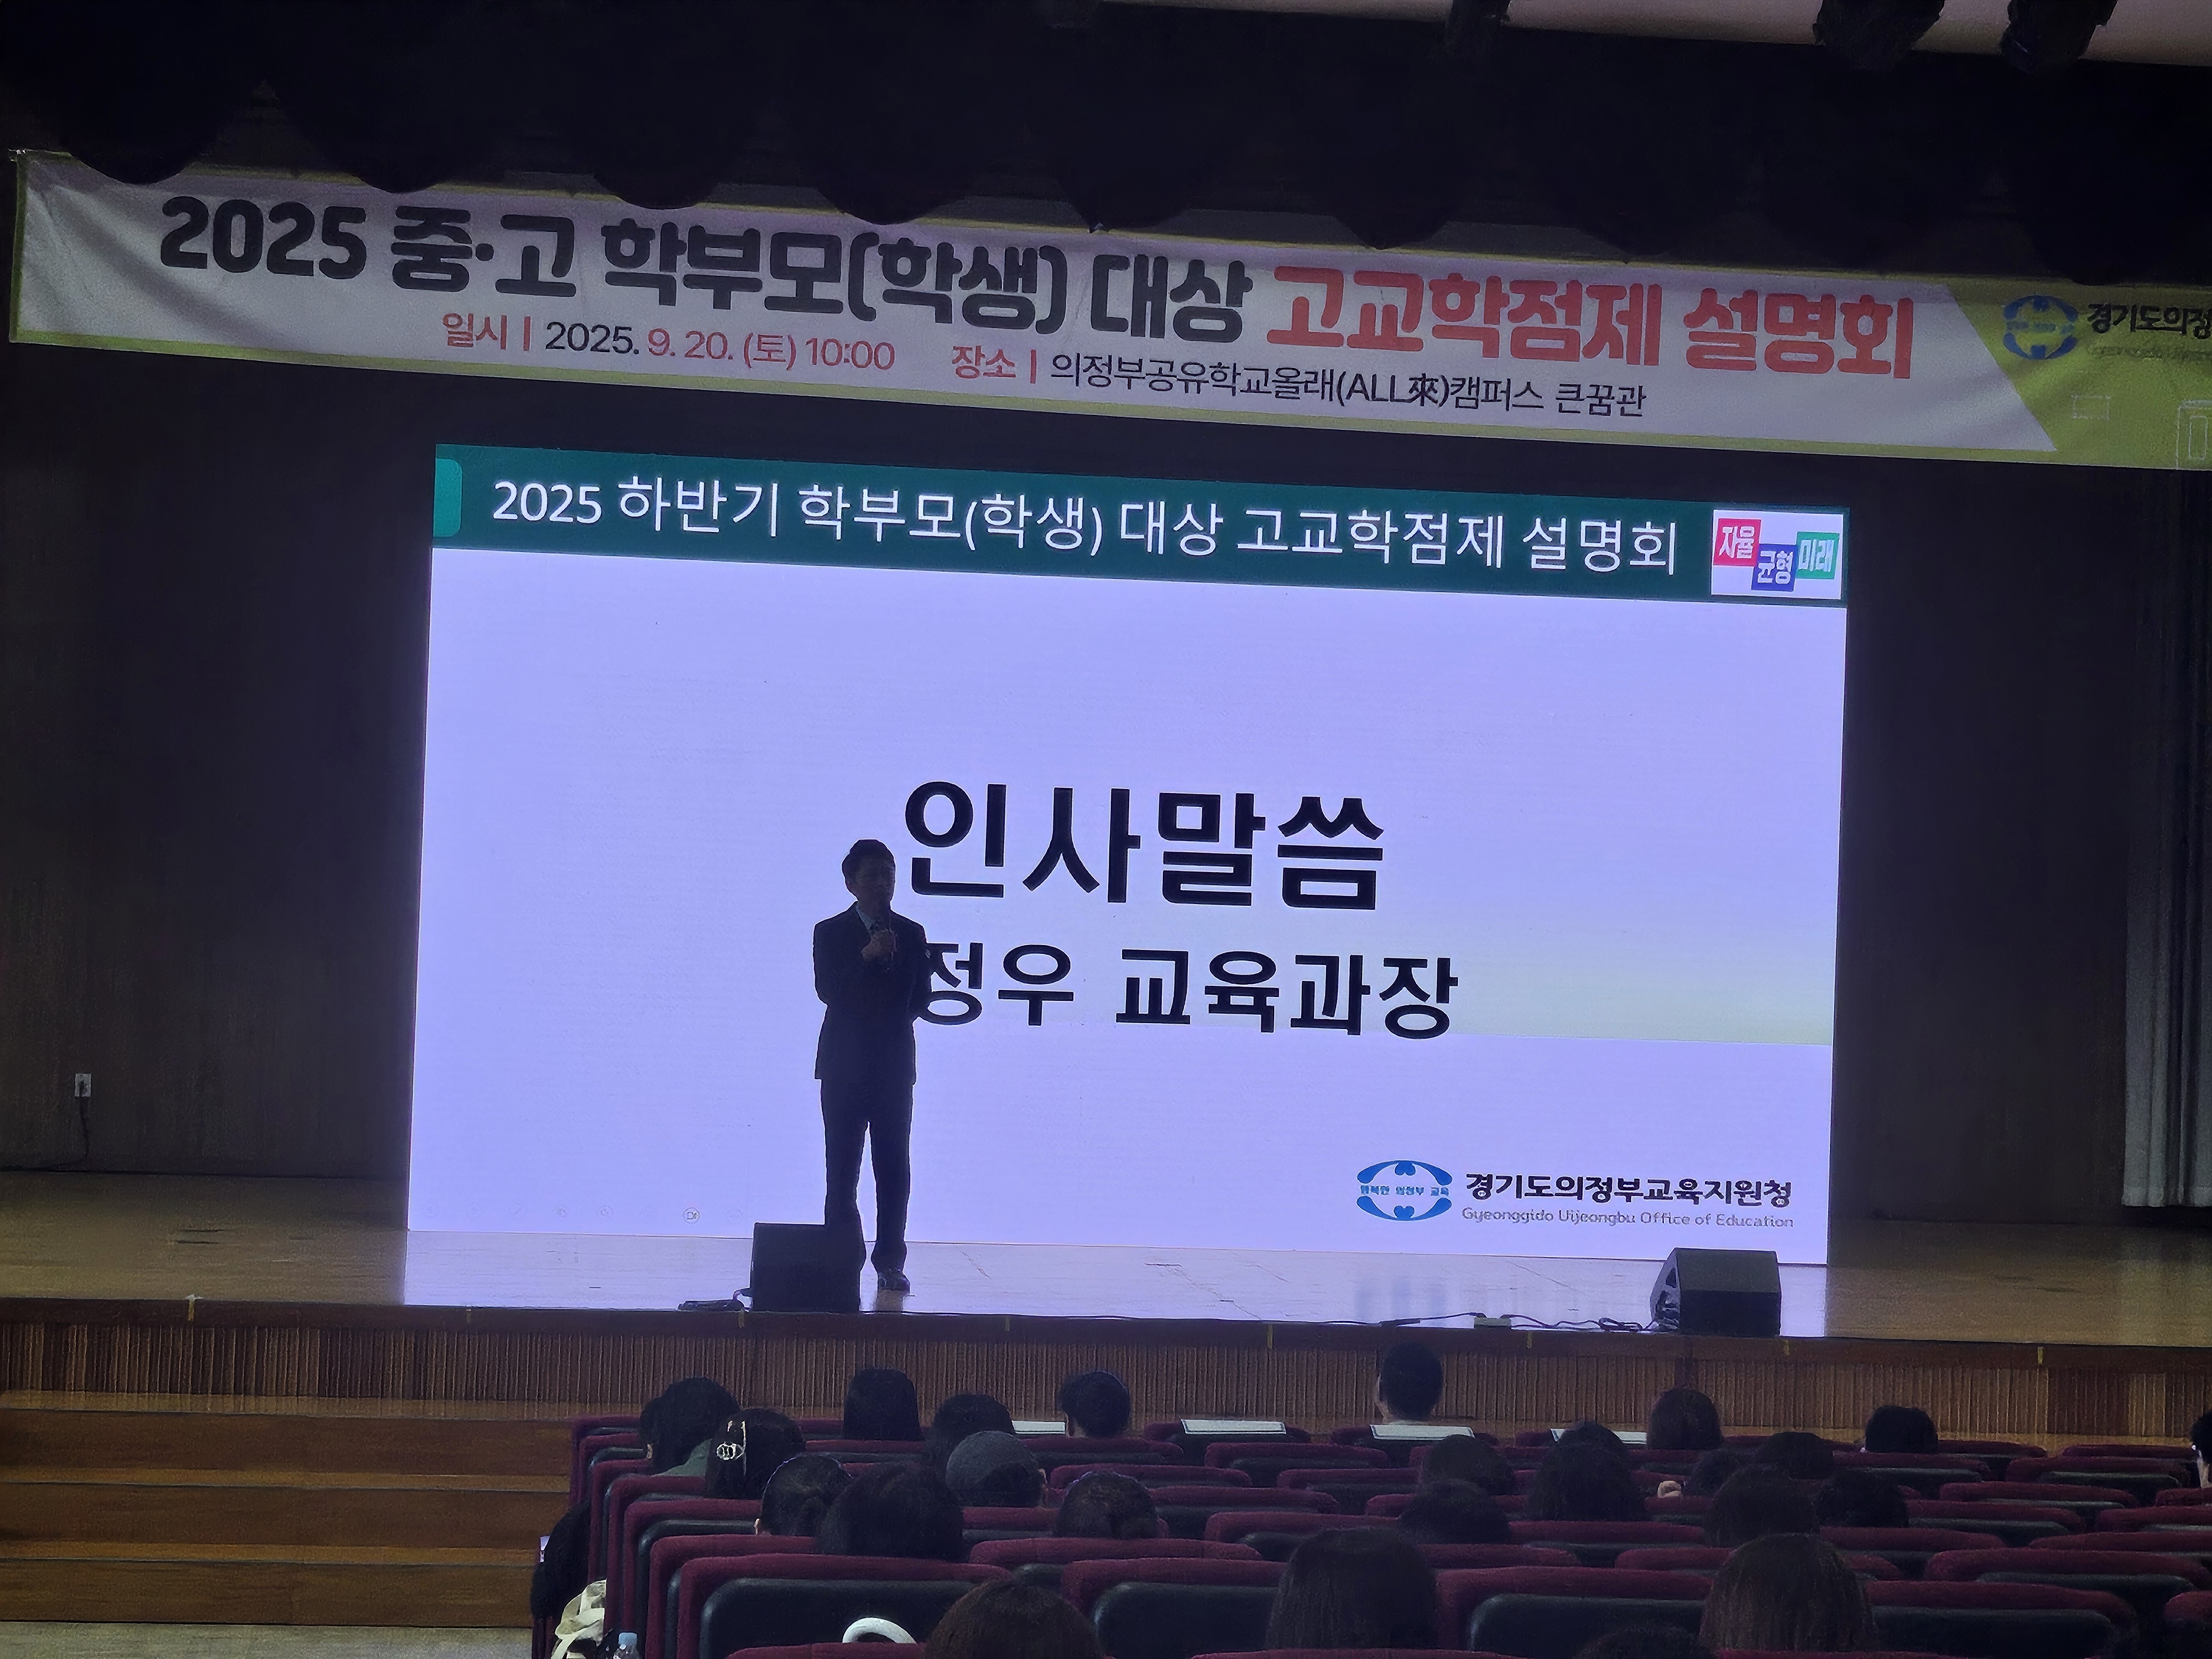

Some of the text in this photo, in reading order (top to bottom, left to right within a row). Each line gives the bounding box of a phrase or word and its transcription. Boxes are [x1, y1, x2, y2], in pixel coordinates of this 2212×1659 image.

[161, 196, 366, 279] 2025
[601, 218, 1068, 334] 학부모(학생)
[1091, 254, 1253, 343] 대상
[1266, 265, 1662, 366] 고교학점제
[1683, 288, 1914, 379] 설명회
[443, 313, 507, 349] 일시
[806, 338, 895, 370] 10:00
[952, 346, 1016, 379] 장소
[1556, 384, 1646, 416] 큰꿈관
[493, 476, 1675, 575] 2025 하반기 학부모(학생) 대상 고교학점제 설명회
[1798, 539, 1834, 572] 미래
[1757, 550, 1793, 584] 균형
[905, 781, 1384, 910] 인사말씀
[1116, 950, 1458, 1039] 교육과장
[1462, 1207, 1793, 1227] Gyeonggido Uijeongbu Office of Education
[1466, 1173, 1792, 1208] 경기도의정부교육지원청
